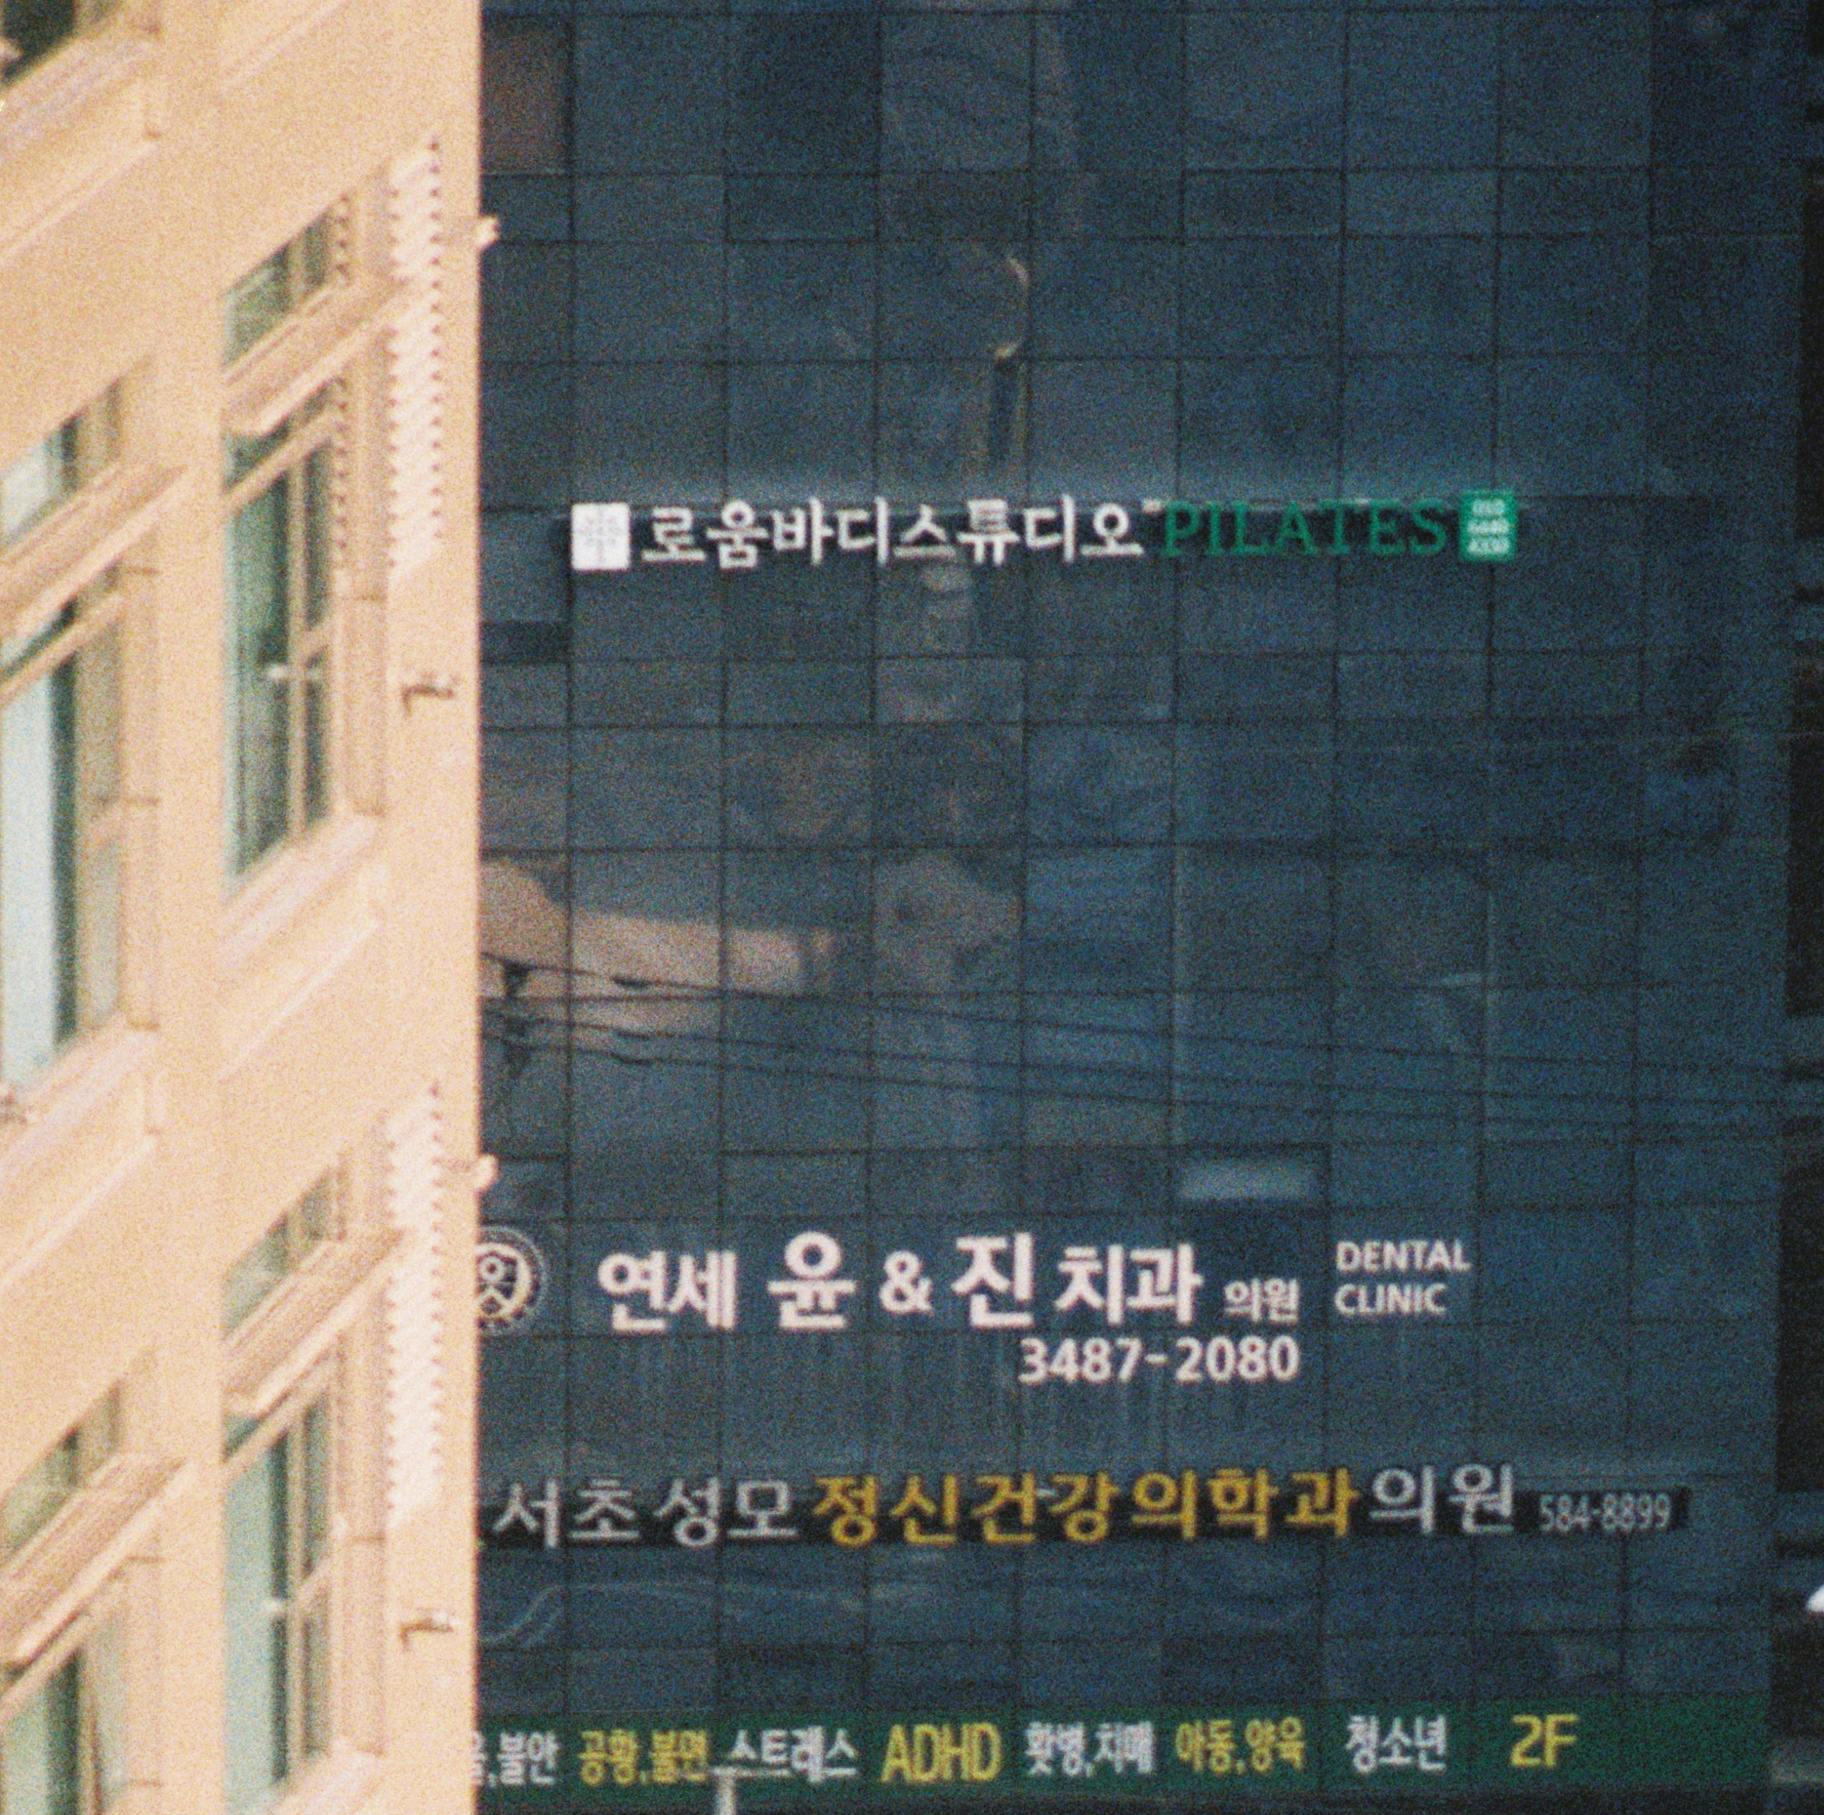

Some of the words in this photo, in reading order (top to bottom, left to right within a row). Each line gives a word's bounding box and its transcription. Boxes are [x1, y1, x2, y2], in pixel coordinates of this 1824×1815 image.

[1164, 498, 1449, 561] PILATES
[598, 1248, 739, 1332] 연세
[768, 1231, 856, 1331] 윤
[951, 1231, 1034, 1329] 진
[1057, 1243, 1203, 1326] 치과
[1224, 1278, 1300, 1324] 의원
[1336, 1238, 1471, 1273] DENTAL
[1335, 1284, 1447, 1316] CLINIC
[1018, 1335, 1299, 1384] 3487-2080
[881, 1721, 1003, 1785] ADHD
[1346, 1714, 1447, 1773] 청소년
[1509, 1712, 1579, 1770] 2F
